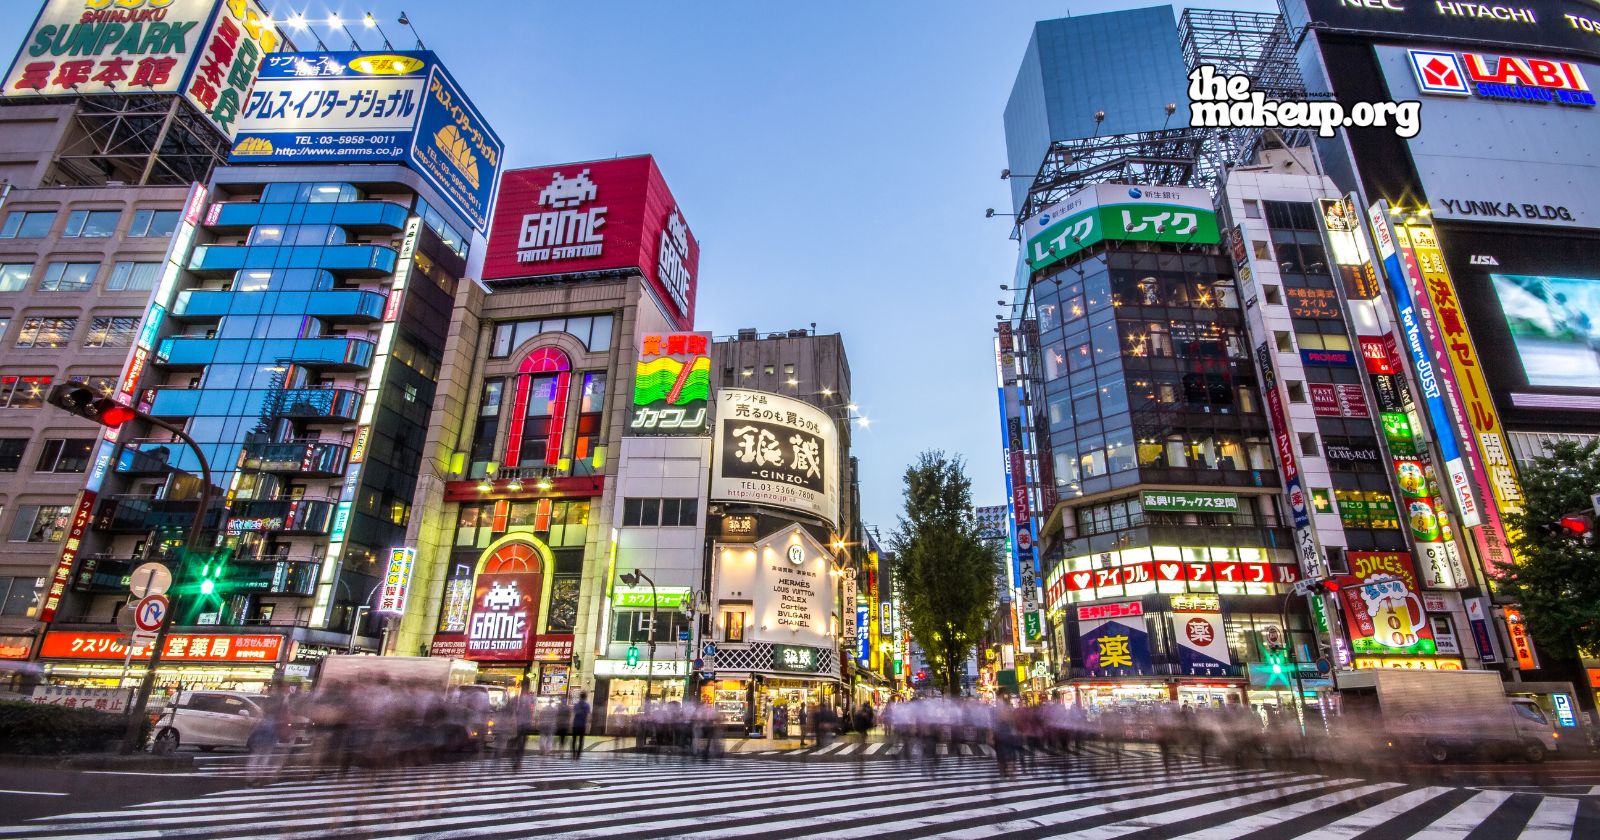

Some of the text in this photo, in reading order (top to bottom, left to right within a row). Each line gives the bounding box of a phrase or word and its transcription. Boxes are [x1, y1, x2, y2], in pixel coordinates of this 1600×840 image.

[80, 9, 168, 24] SHINJUKU
[1436, 1, 1537, 23] HITACHI
[29, 21, 199, 57] SUNPARK
[15, 57, 178, 90] 三平本館
[1462, 53, 1590, 92] LABI
[1475, 82, 1553, 102] SHINJUKU
[244, 89, 415, 119] アムス・インターナショナル
[275, 146, 403, 157] http://www.amms.co.jp
[1145, 191, 1180, 200] 新生銀行
[1440, 198, 1576, 222] YUNIKA BLDG.
[518, 206, 608, 248] GAME
[1122, 209, 1197, 235] レイク
[1035, 215, 1093, 262] レイク
[517, 243, 603, 263] TAITO STATION
[1292, 308, 1338, 318] マッサージ
[1300, 299, 1327, 308] オイル
[1402, 307, 1414, 328] For
[1408, 326, 1423, 352] Your
[643, 335, 708, 356] 質・買取
[1362, 343, 1383, 352] FAST
[1364, 350, 1386, 359] NAIL
[1308, 353, 1348, 362] PROMISE
[725, 392, 768, 405] ブランド品
[631, 408, 707, 428] カワノ
[735, 403, 821, 434] 売るのも 買うのも
[1279, 434, 1295, 478] アイフル
[728, 489, 787, 502] http://ginzo.jp
[742, 481, 815, 501] TEL.03-5366-7800
[1291, 491, 1304, 507] 薬
[1459, 485, 1475, 515] LABI
[1016, 489, 1028, 522] アイフル
[1019, 534, 1030, 545] 薬
[1301, 530, 1320, 576] 大勝軒
[383, 552, 404, 609] まんが喫茶
[1022, 563, 1035, 599] 大勝軒
[1096, 565, 1149, 587] アイフル
[1191, 564, 1295, 583] アイフル
[1356, 555, 1413, 590] カルビちゃん
[773, 585, 815, 597] LOUIS VUITTON
[782, 594, 807, 603] ROLEX
[777, 610, 811, 620] BVLGARI
[780, 602, 808, 612] Cartier
[470, 612, 527, 639] GAME
[777, 618, 810, 628] CHANEL
[1028, 614, 1037, 636] レイク
[1189, 621, 1212, 642] 薬
[235, 637, 277, 648] 処方せん受付
[469, 640, 490, 650] TAITO
[491, 640, 522, 650] STATION
[1097, 634, 1133, 668] 薬
[1556, 696, 1566, 709] P
